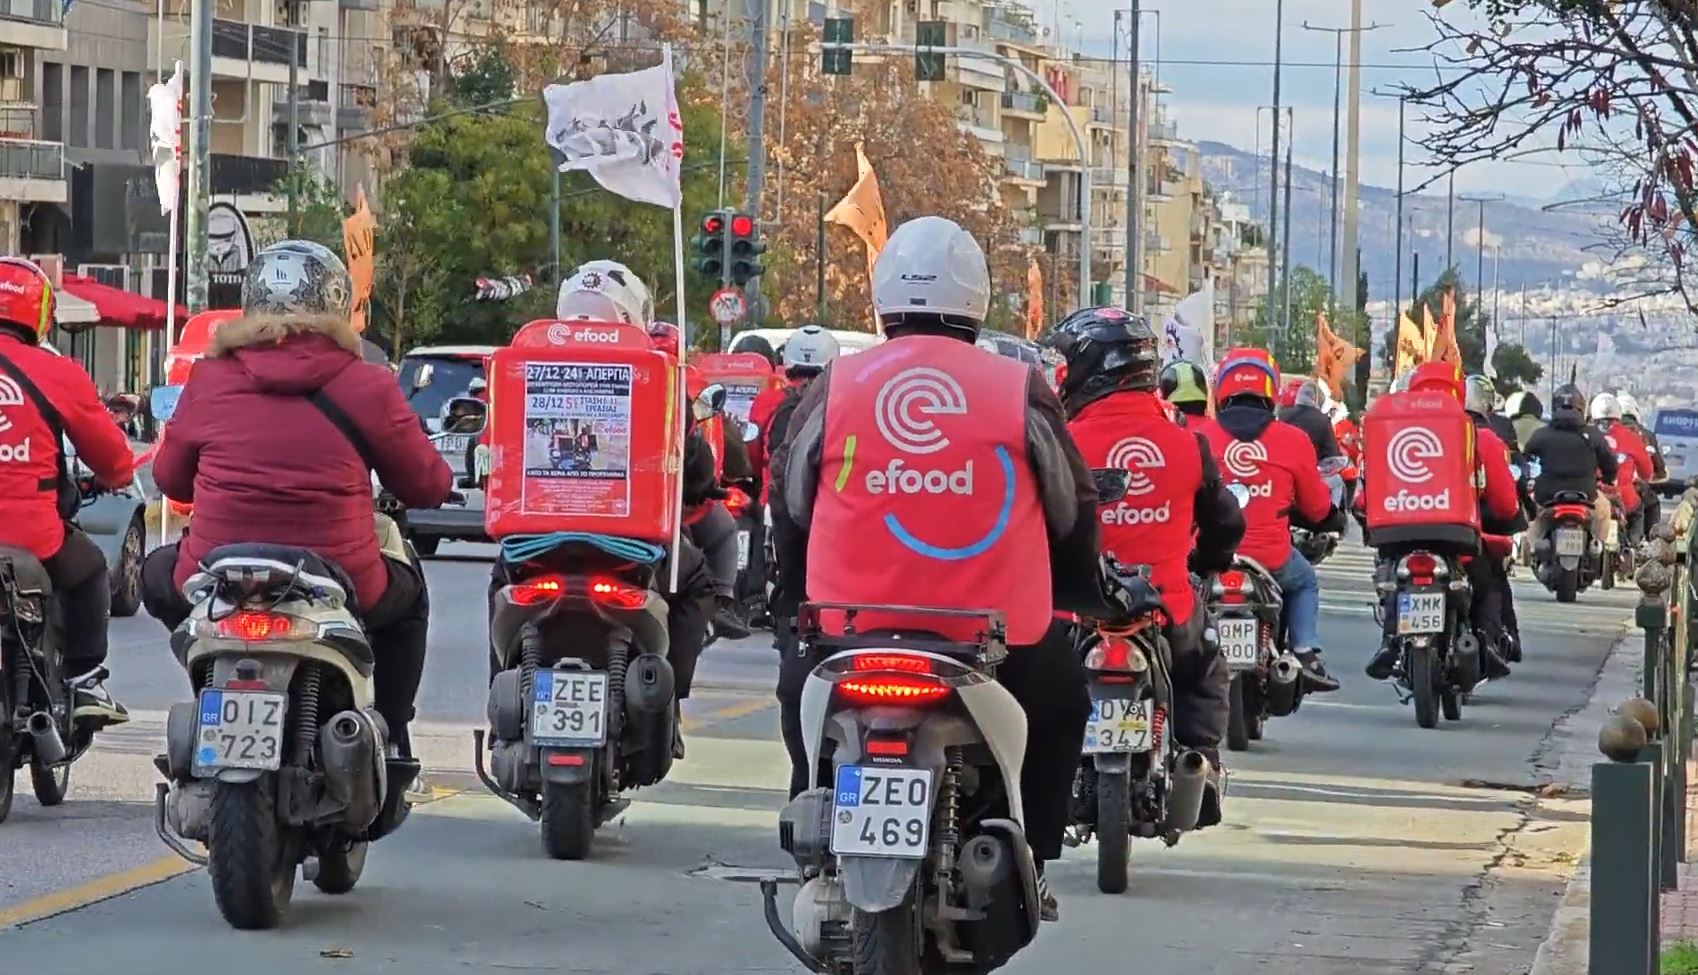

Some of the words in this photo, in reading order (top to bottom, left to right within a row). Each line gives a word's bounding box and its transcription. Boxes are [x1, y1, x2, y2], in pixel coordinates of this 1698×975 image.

[574, 328, 619, 343] efood
[532, 397, 564, 410] 28/12
[865, 459, 973, 495] efood
[1384, 488, 1450, 511] efood
[1101, 500, 1170, 525] efood
[1411, 615, 1441, 629] 456
[554, 679, 602, 702] ZEE
[202, 712, 218, 723] GR
[223, 700, 280, 726] OIZ
[552, 709, 600, 733] 391
[221, 734, 277, 760] 723
[1100, 729, 1148, 748] 347
[840, 792, 857, 803] GR
[862, 776, 927, 806] ZEO
[859, 816, 924, 847] 469
